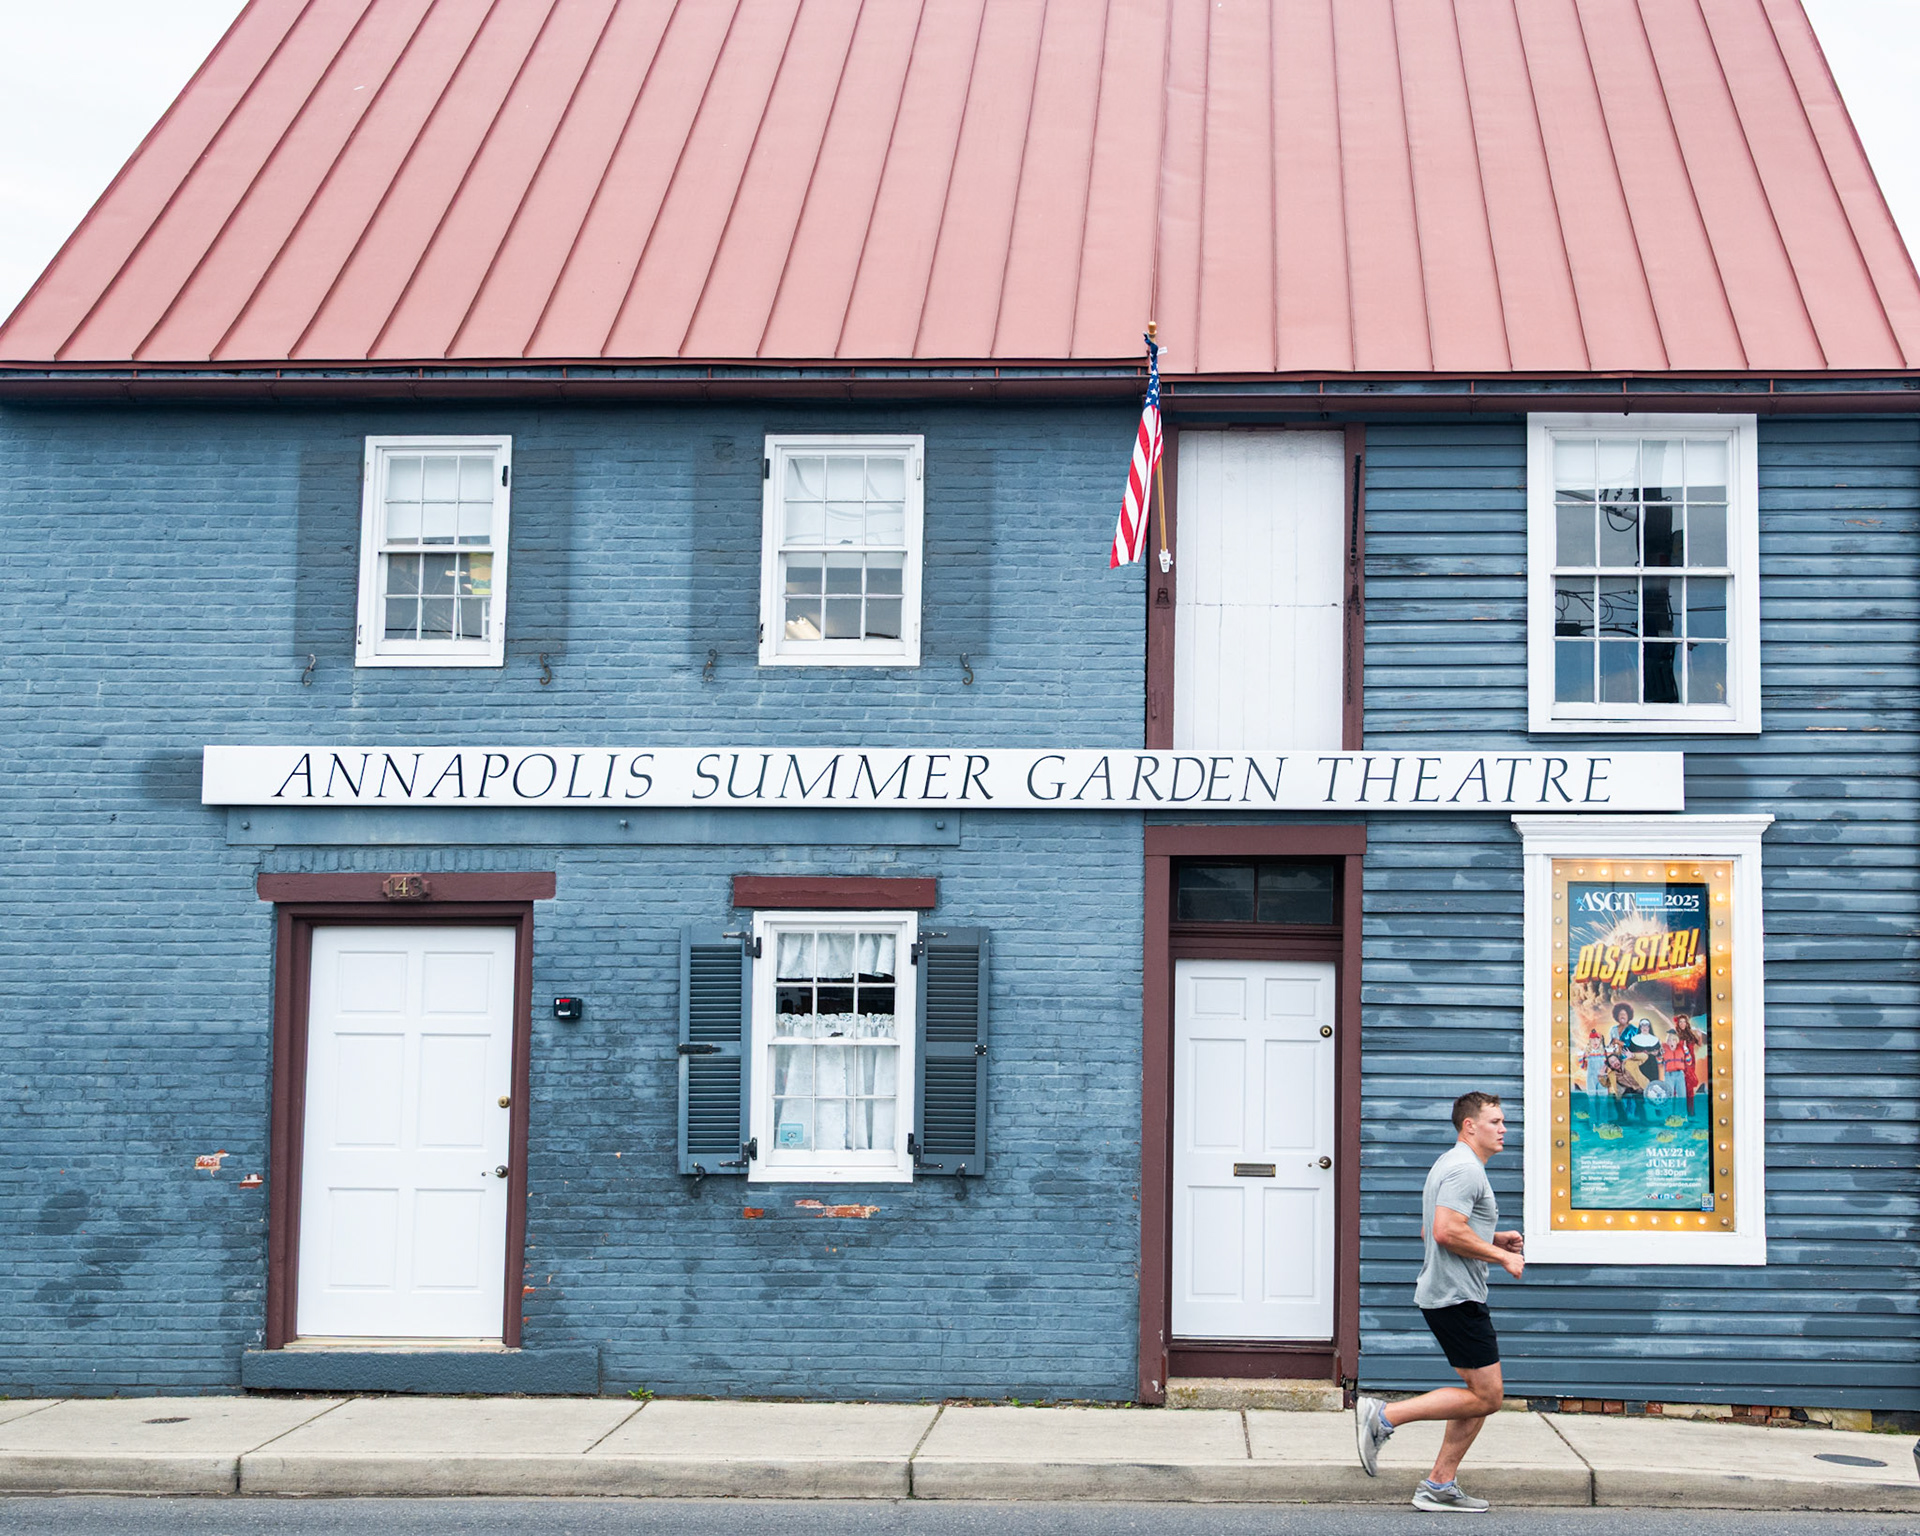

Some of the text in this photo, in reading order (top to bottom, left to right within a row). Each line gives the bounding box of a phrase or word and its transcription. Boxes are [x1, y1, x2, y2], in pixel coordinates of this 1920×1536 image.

[273, 753, 1612, 803] ANNAPOLIS SUMMER GARDEN THEATRE
[388, 877, 423, 897] 143
[1578, 892, 1635, 911] ASGT
[1664, 895, 1700, 908] 2025
[1576, 928, 1700, 989] DISASTER!
[1684, 1148, 1695, 1157] to
